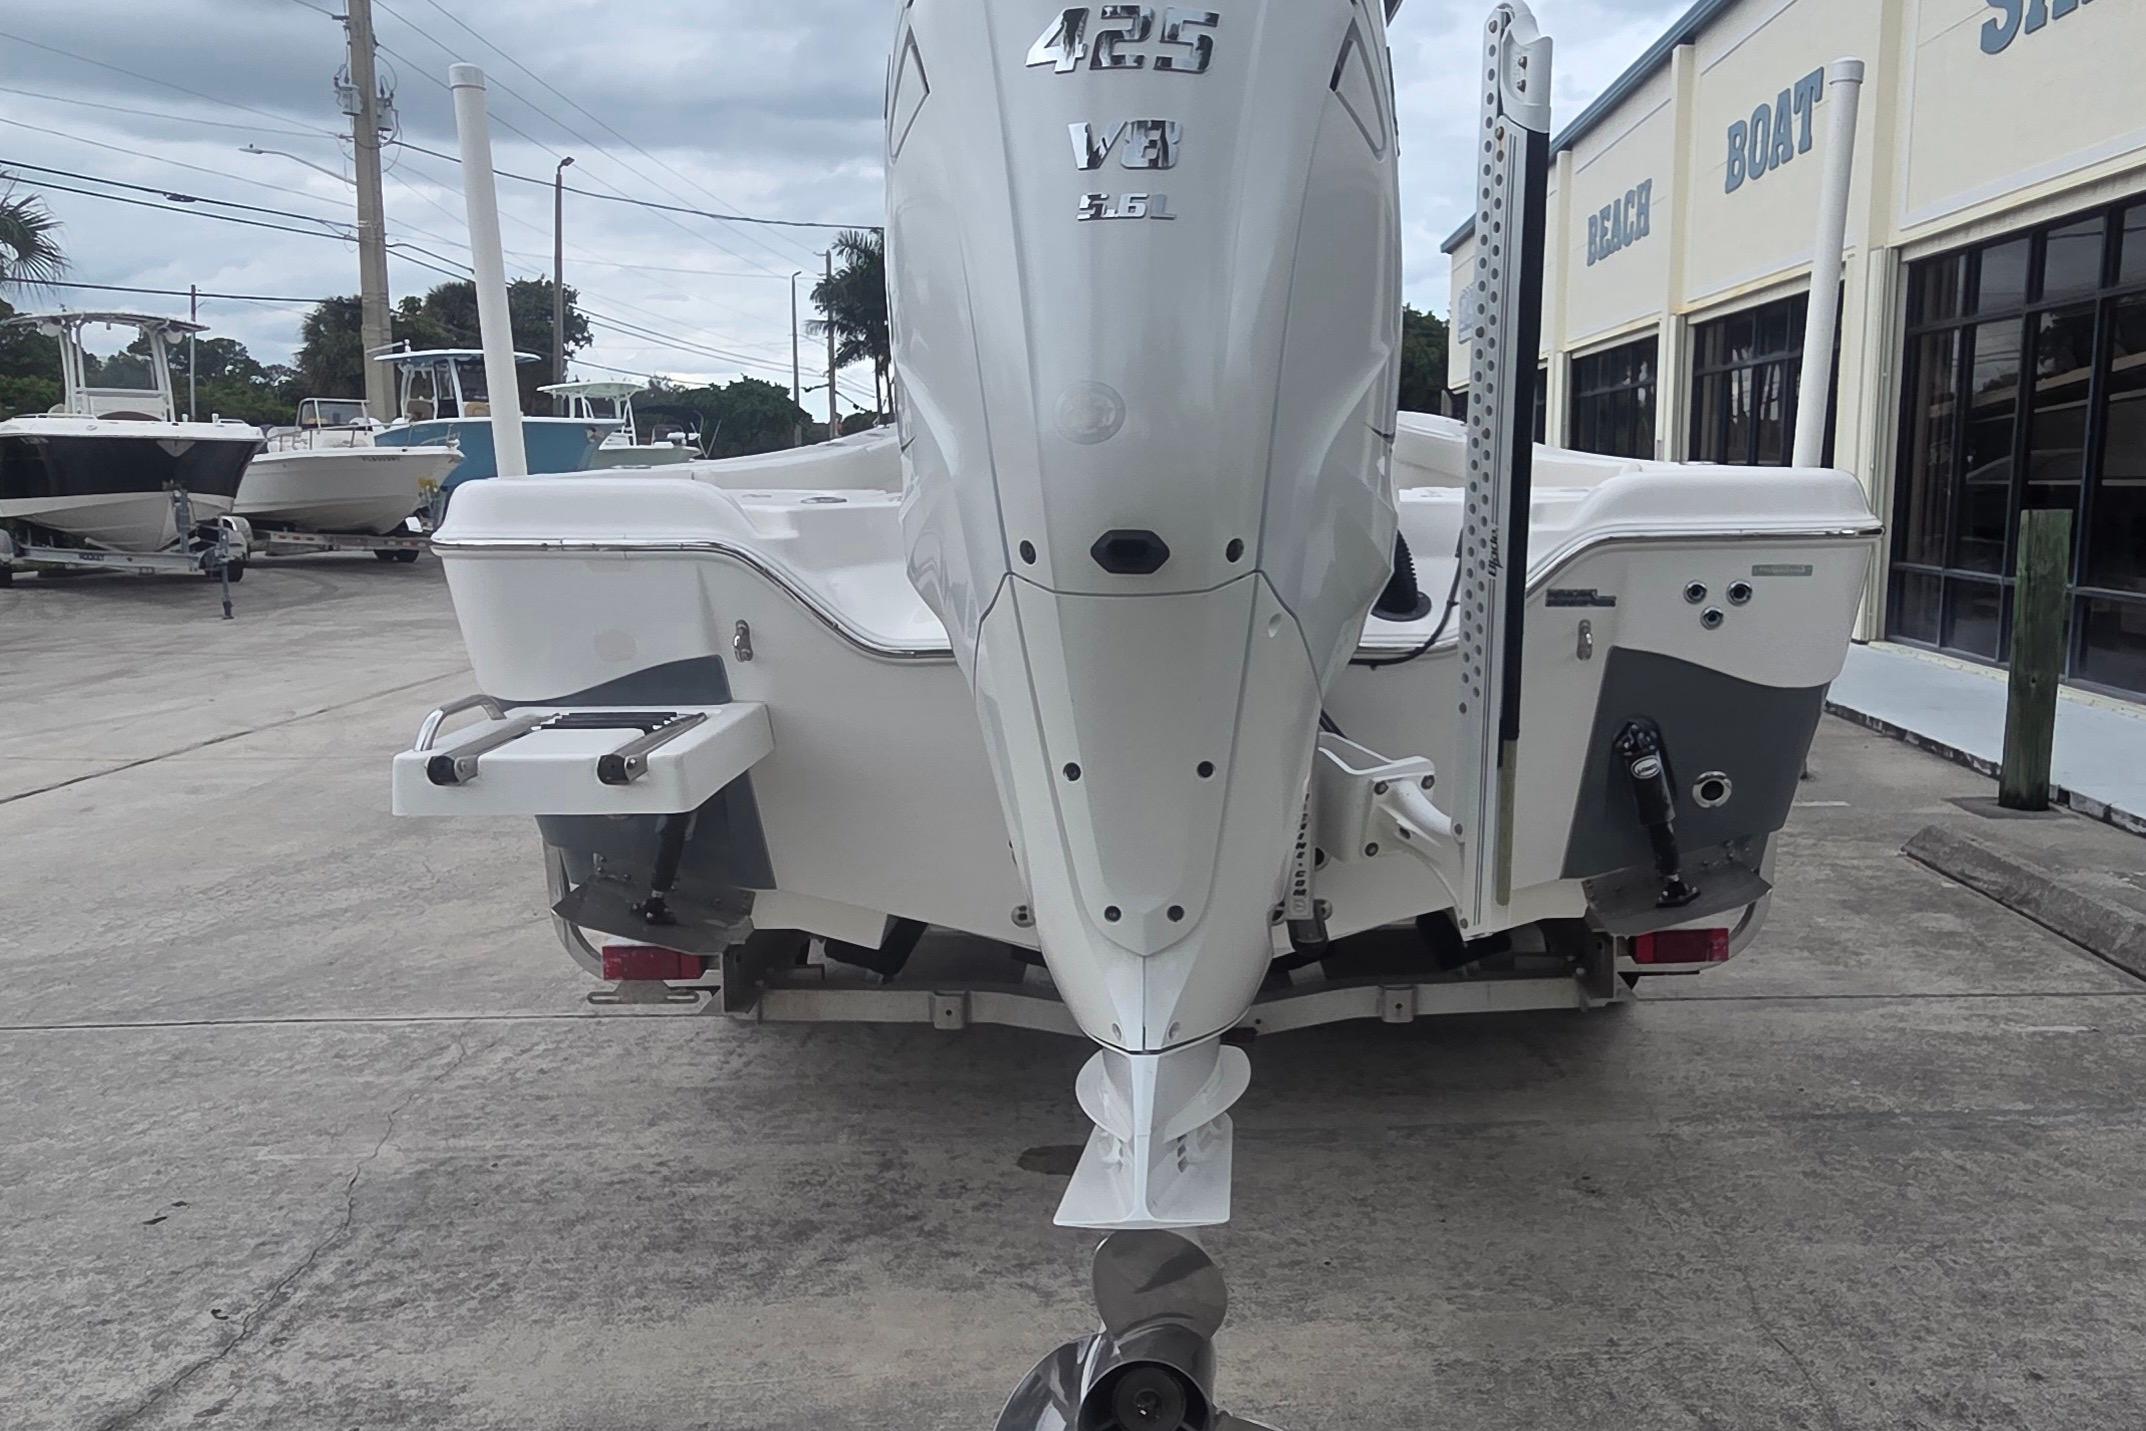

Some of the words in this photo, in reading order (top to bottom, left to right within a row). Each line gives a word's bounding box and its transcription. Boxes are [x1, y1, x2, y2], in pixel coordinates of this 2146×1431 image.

[1025, 5, 1220, 73] 425
[1067, 119, 1183, 170] V8
[1587, 178, 1652, 267] BEACH
[1725, 66, 1824, 194] BOAT
[1077, 193, 1177, 220] 5.6L
